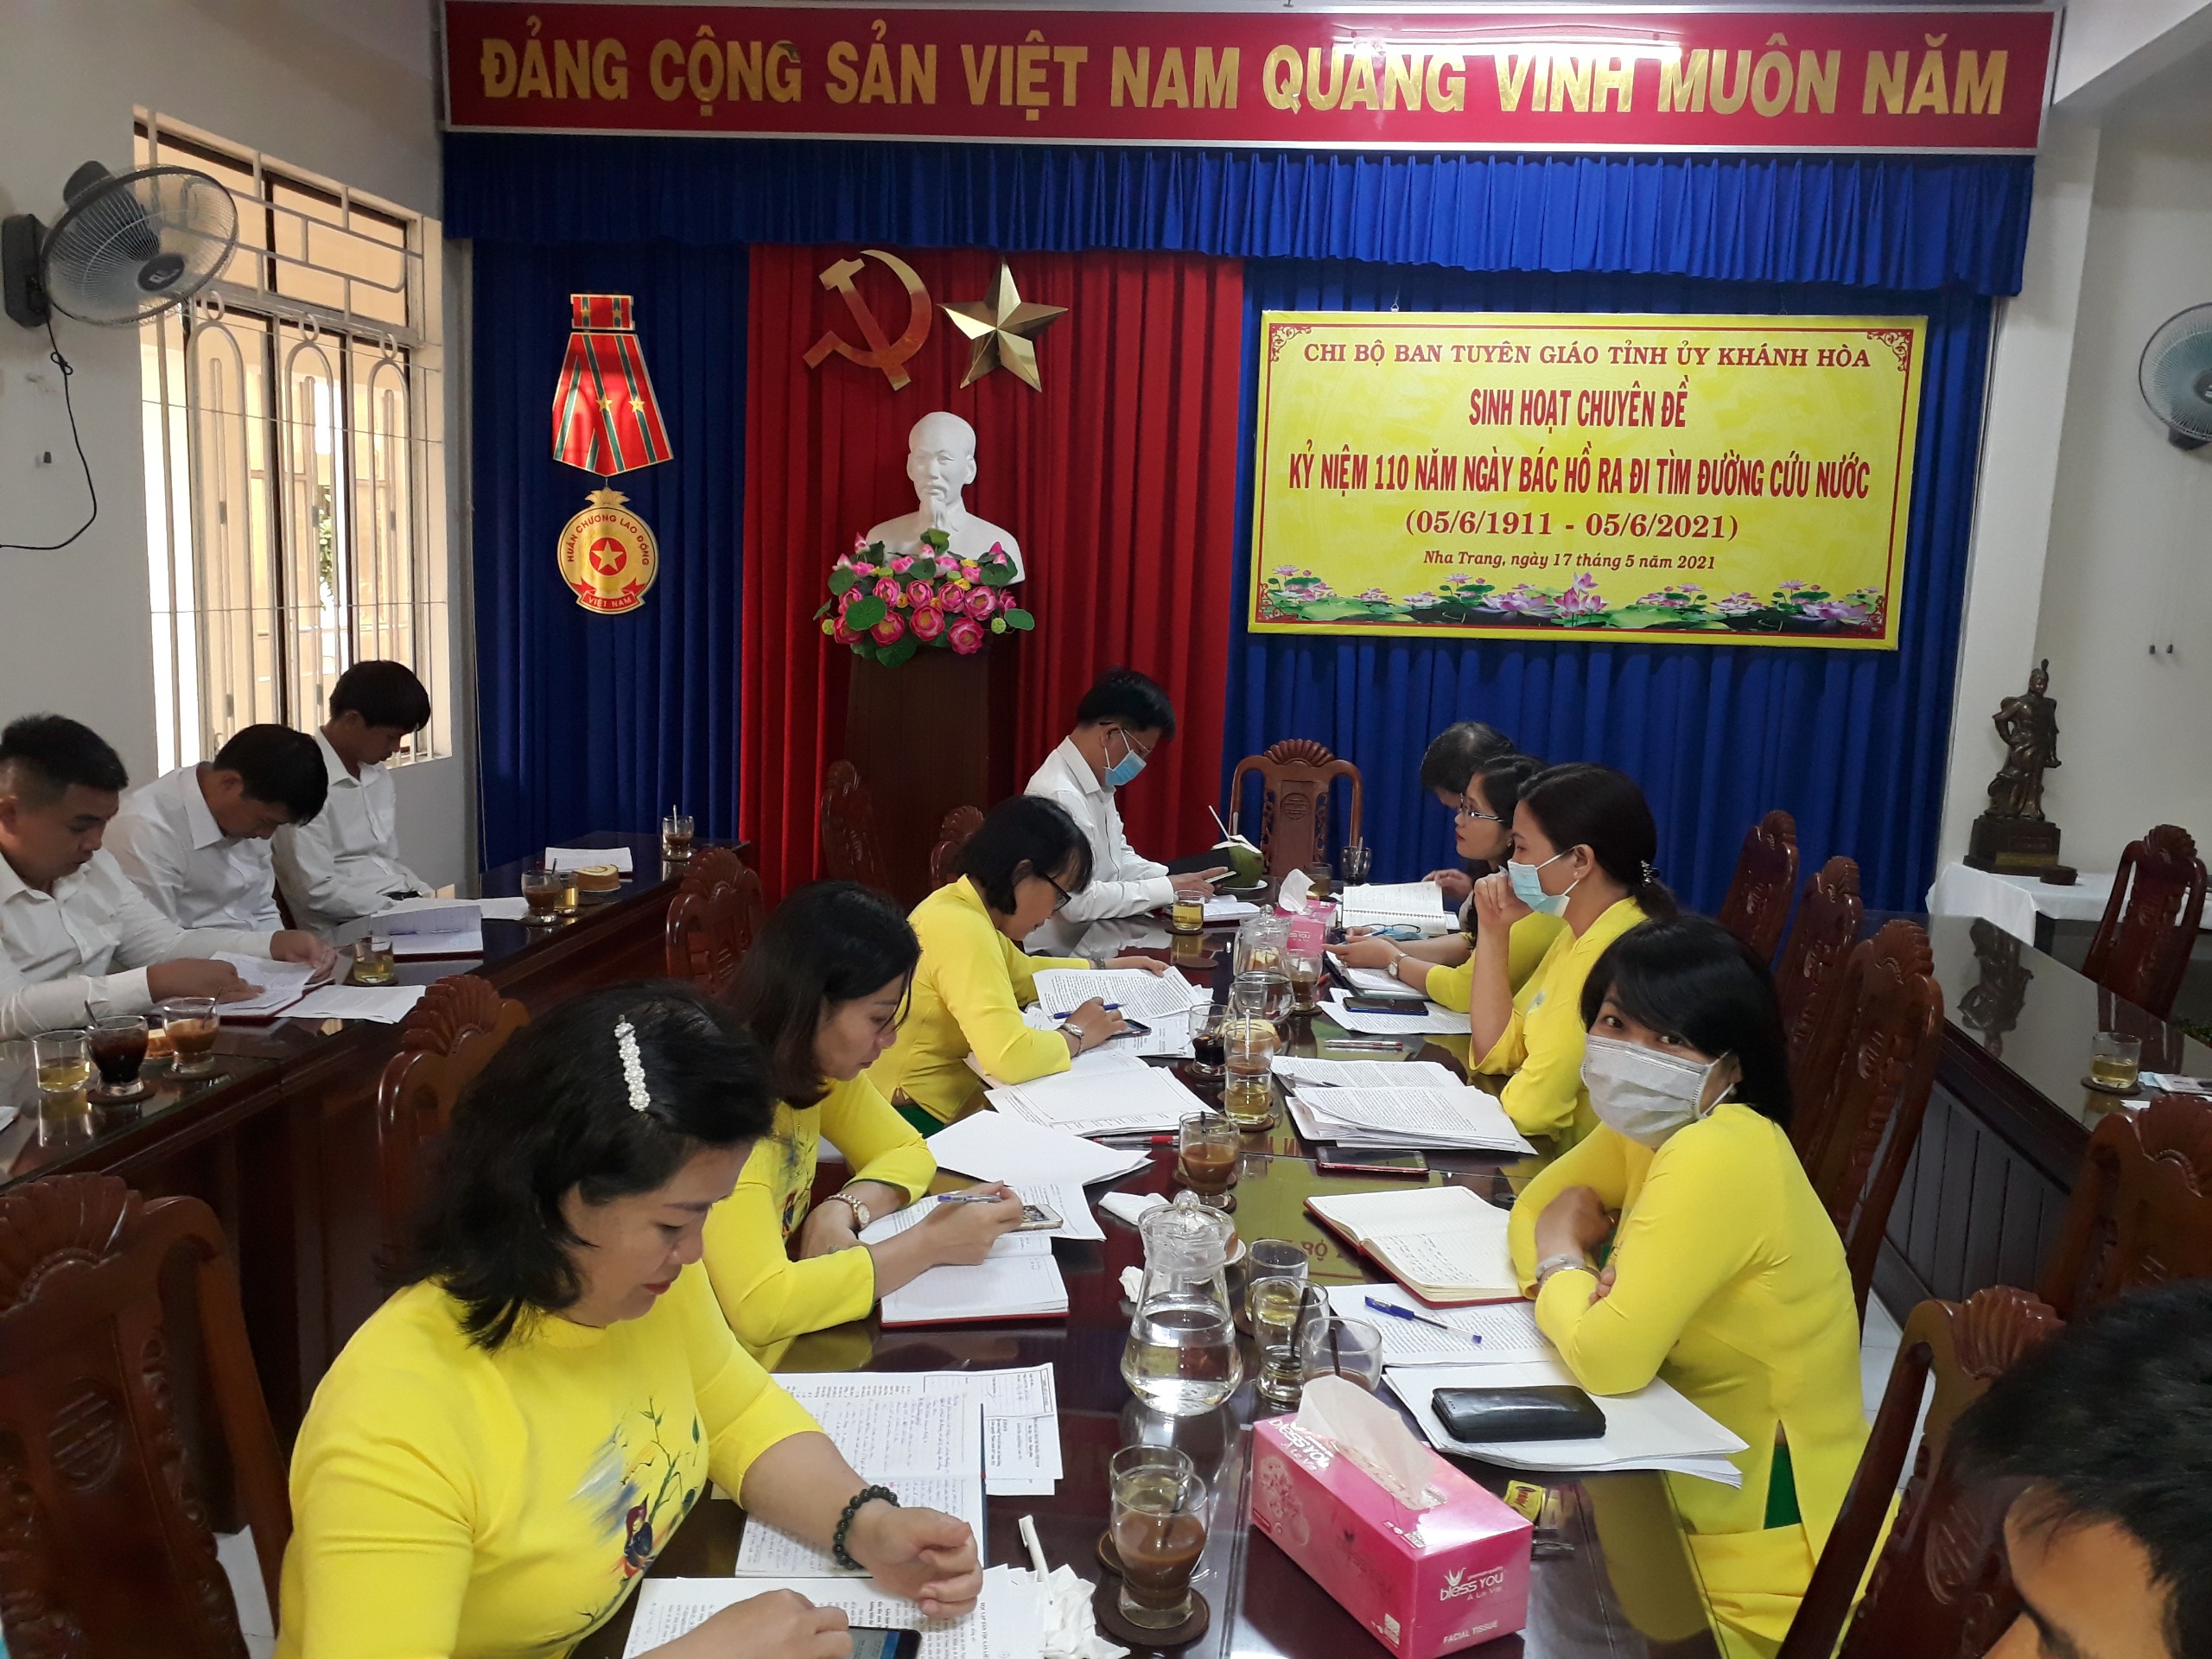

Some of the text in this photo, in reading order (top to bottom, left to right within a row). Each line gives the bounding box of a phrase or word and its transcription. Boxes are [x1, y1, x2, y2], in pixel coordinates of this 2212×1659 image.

[480, 16, 2007, 121] ĐẢNG CỘNG SẢN VIỆT NAM QUANG VINH MUÔN NĂM
[1304, 339, 1871, 368] CHI BỘ BAN TUYÊN GIÁO TỈNH ỦY KHÁNH HÒA
[1468, 374, 1689, 434] SINH HOẠT CHUYÊN ĐỀ
[1288, 439, 1871, 499] KỶ NIỆM 110 NĂM NGÀY BÁC HỒ RA ĐI TÌM ĐƯỜNG CỨU NƯỚC
[620, 518, 638, 534] LAO
[1406, 510, 1552, 537] (05/6/1911
[1586, 512, 1738, 542] 05/6/2021)
[1423, 550, 1715, 571] Nha Trang, ngày 17 tháng 5 năm 2021
[588, 596, 632, 607] VIỆT NAM
[1479, 1572, 1503, 1588] YOU
